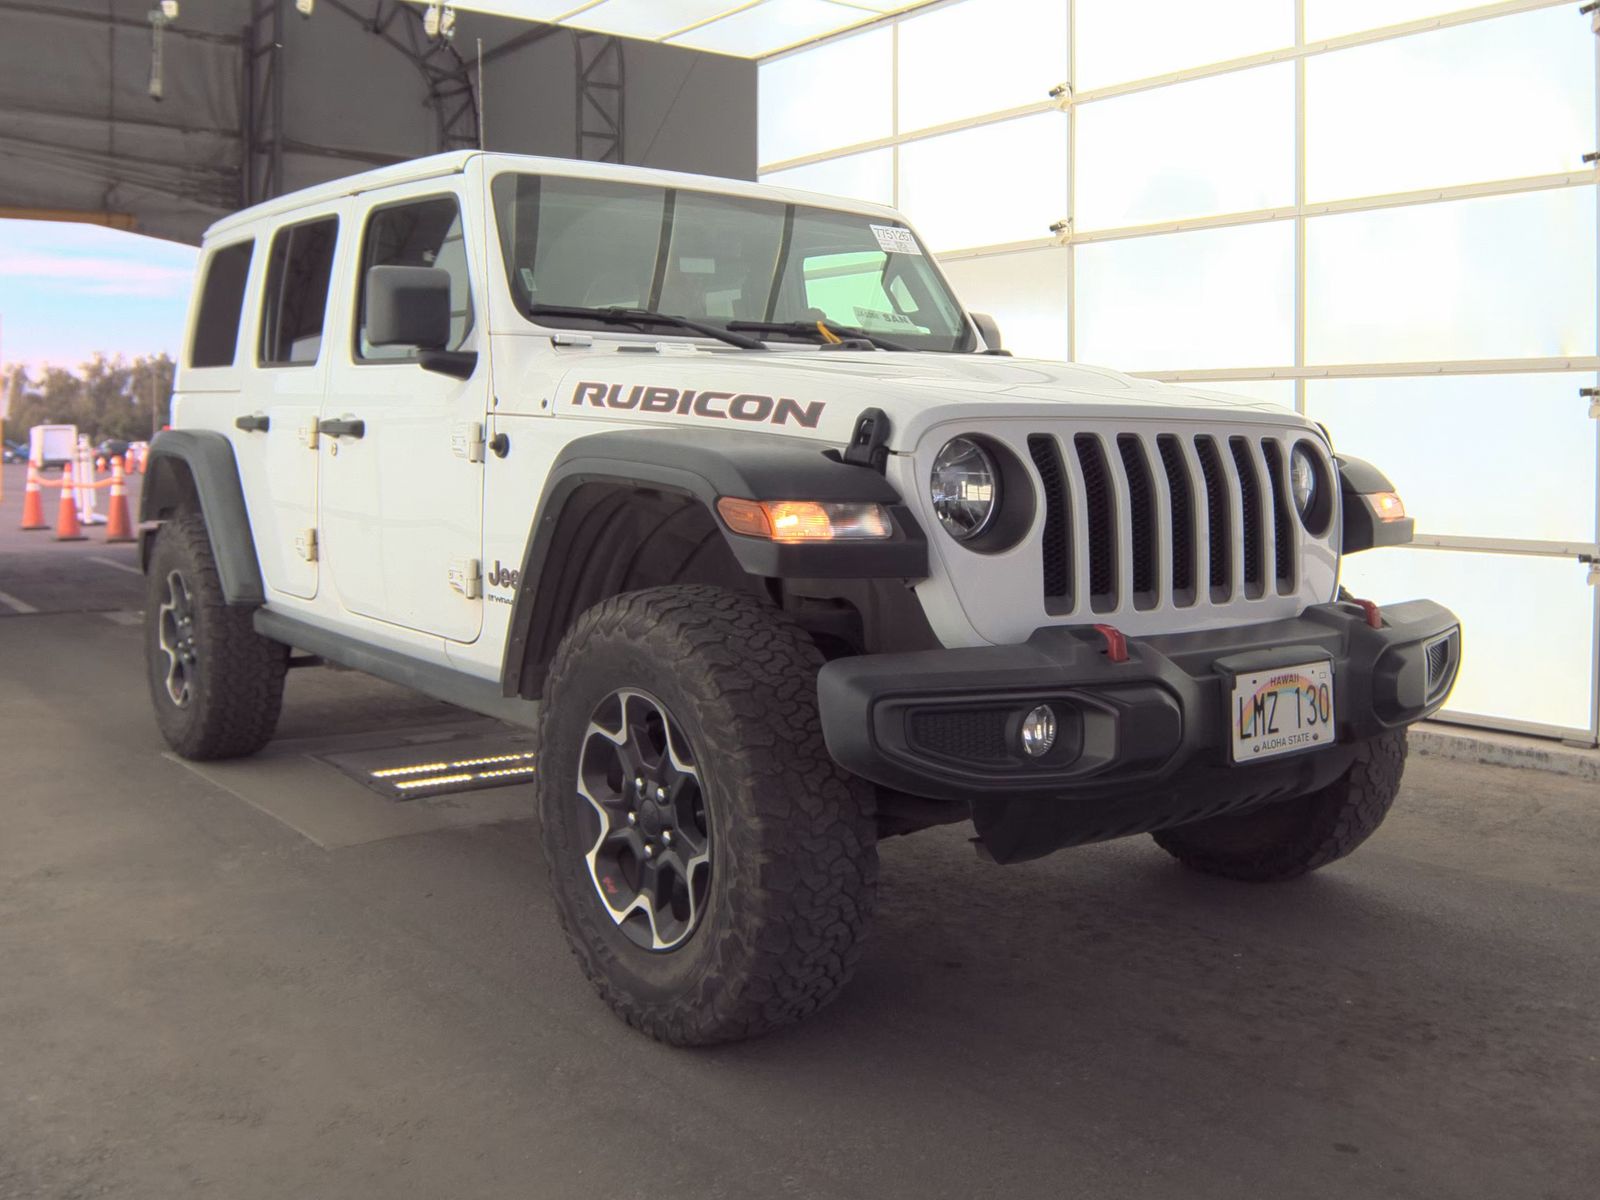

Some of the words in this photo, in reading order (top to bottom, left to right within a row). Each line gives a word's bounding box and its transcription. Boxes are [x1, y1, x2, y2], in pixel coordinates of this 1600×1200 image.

[571, 381, 826, 429] RUBICON
[488, 560, 521, 590] Jee
[1270, 673, 1299, 687] HAWAII
[1239, 690, 1279, 740] LMZ
[1294, 682, 1330, 729] 130
[1261, 737, 1287, 751] ALOHA
[1288, 732, 1310, 746] STATE
